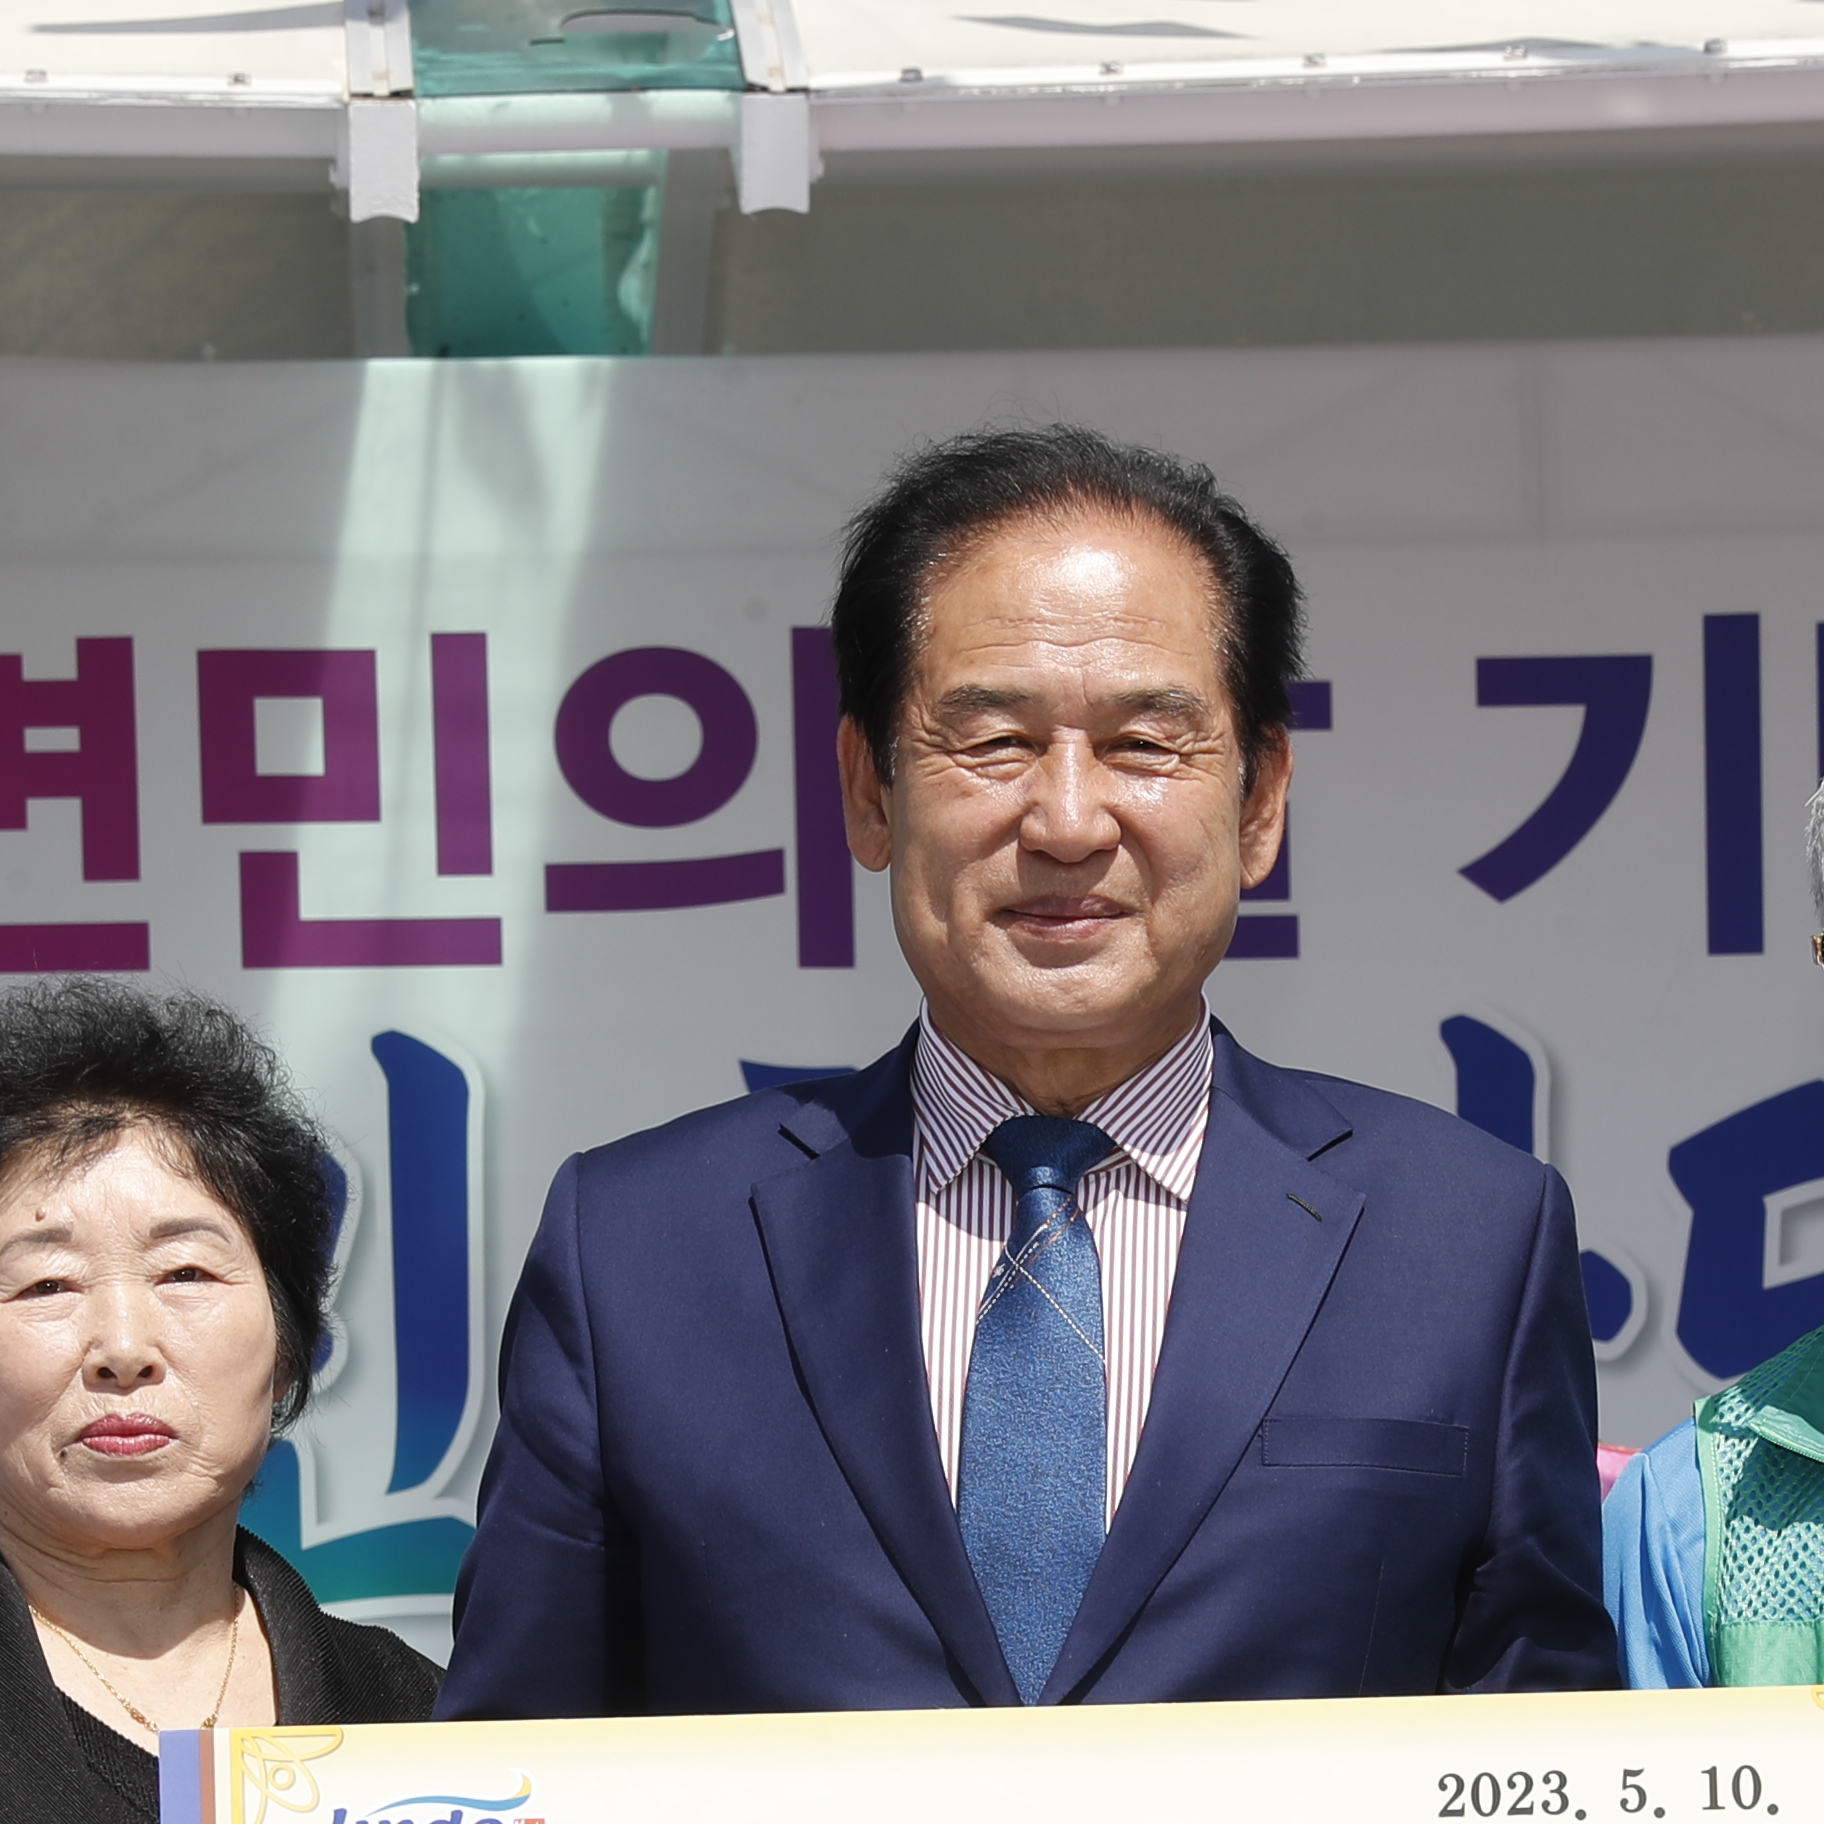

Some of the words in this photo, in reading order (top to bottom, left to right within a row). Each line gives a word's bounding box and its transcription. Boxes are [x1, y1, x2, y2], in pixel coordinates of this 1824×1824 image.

[1437, 1769, 1587, 1820] 2023.
[1619, 1768, 1666, 1819] 5.
[1701, 1764, 1780, 1816] 10.
